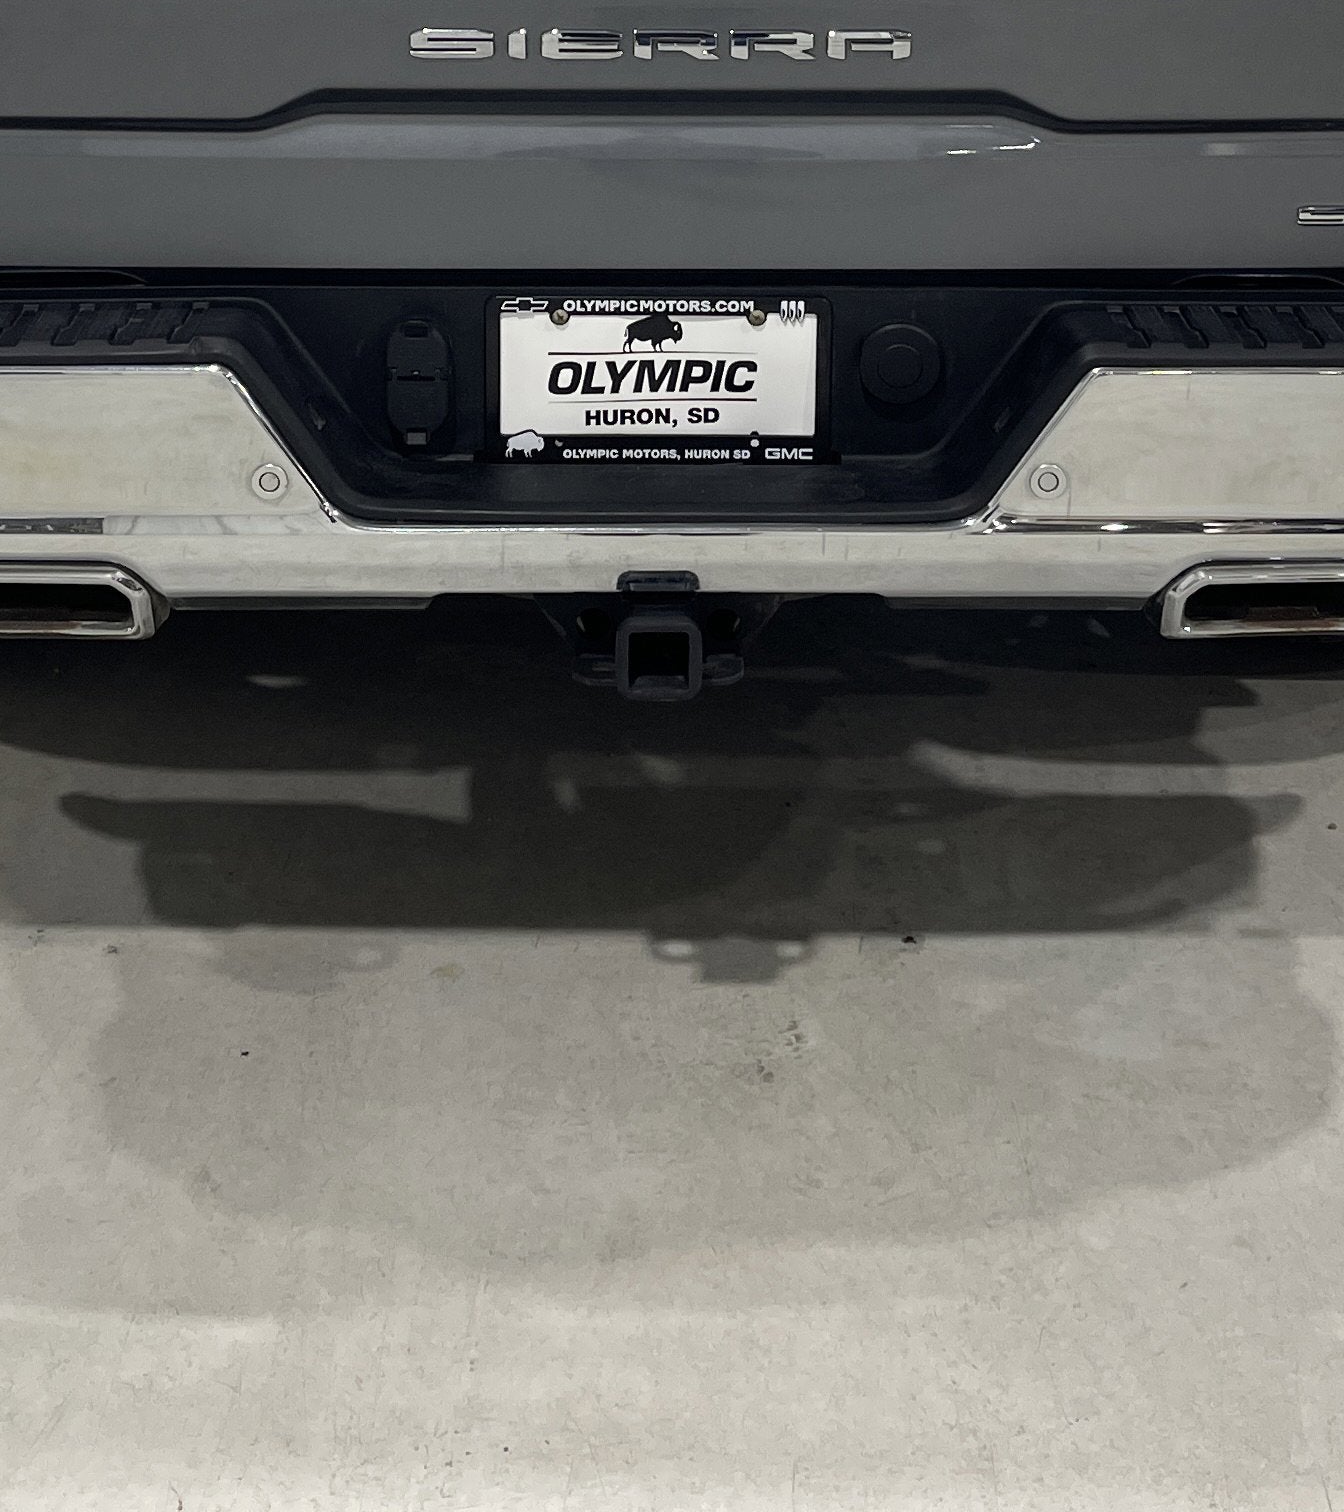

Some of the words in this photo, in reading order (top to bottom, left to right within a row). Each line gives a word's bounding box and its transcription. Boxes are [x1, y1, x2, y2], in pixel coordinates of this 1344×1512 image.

[409, 28, 913, 61] SIERRA
[562, 299, 755, 313] OLYMPICMOTORS.COM
[547, 359, 757, 395] OLYMPIC
[585, 408, 678, 427] HURON,
[687, 407, 720, 424] SD
[562, 449, 619, 459] OLYMPIC
[622, 449, 681, 461] MOTORS,
[684, 449, 730, 459] HURON
[733, 449, 751, 459] SD
[764, 448, 813, 460] GMC
